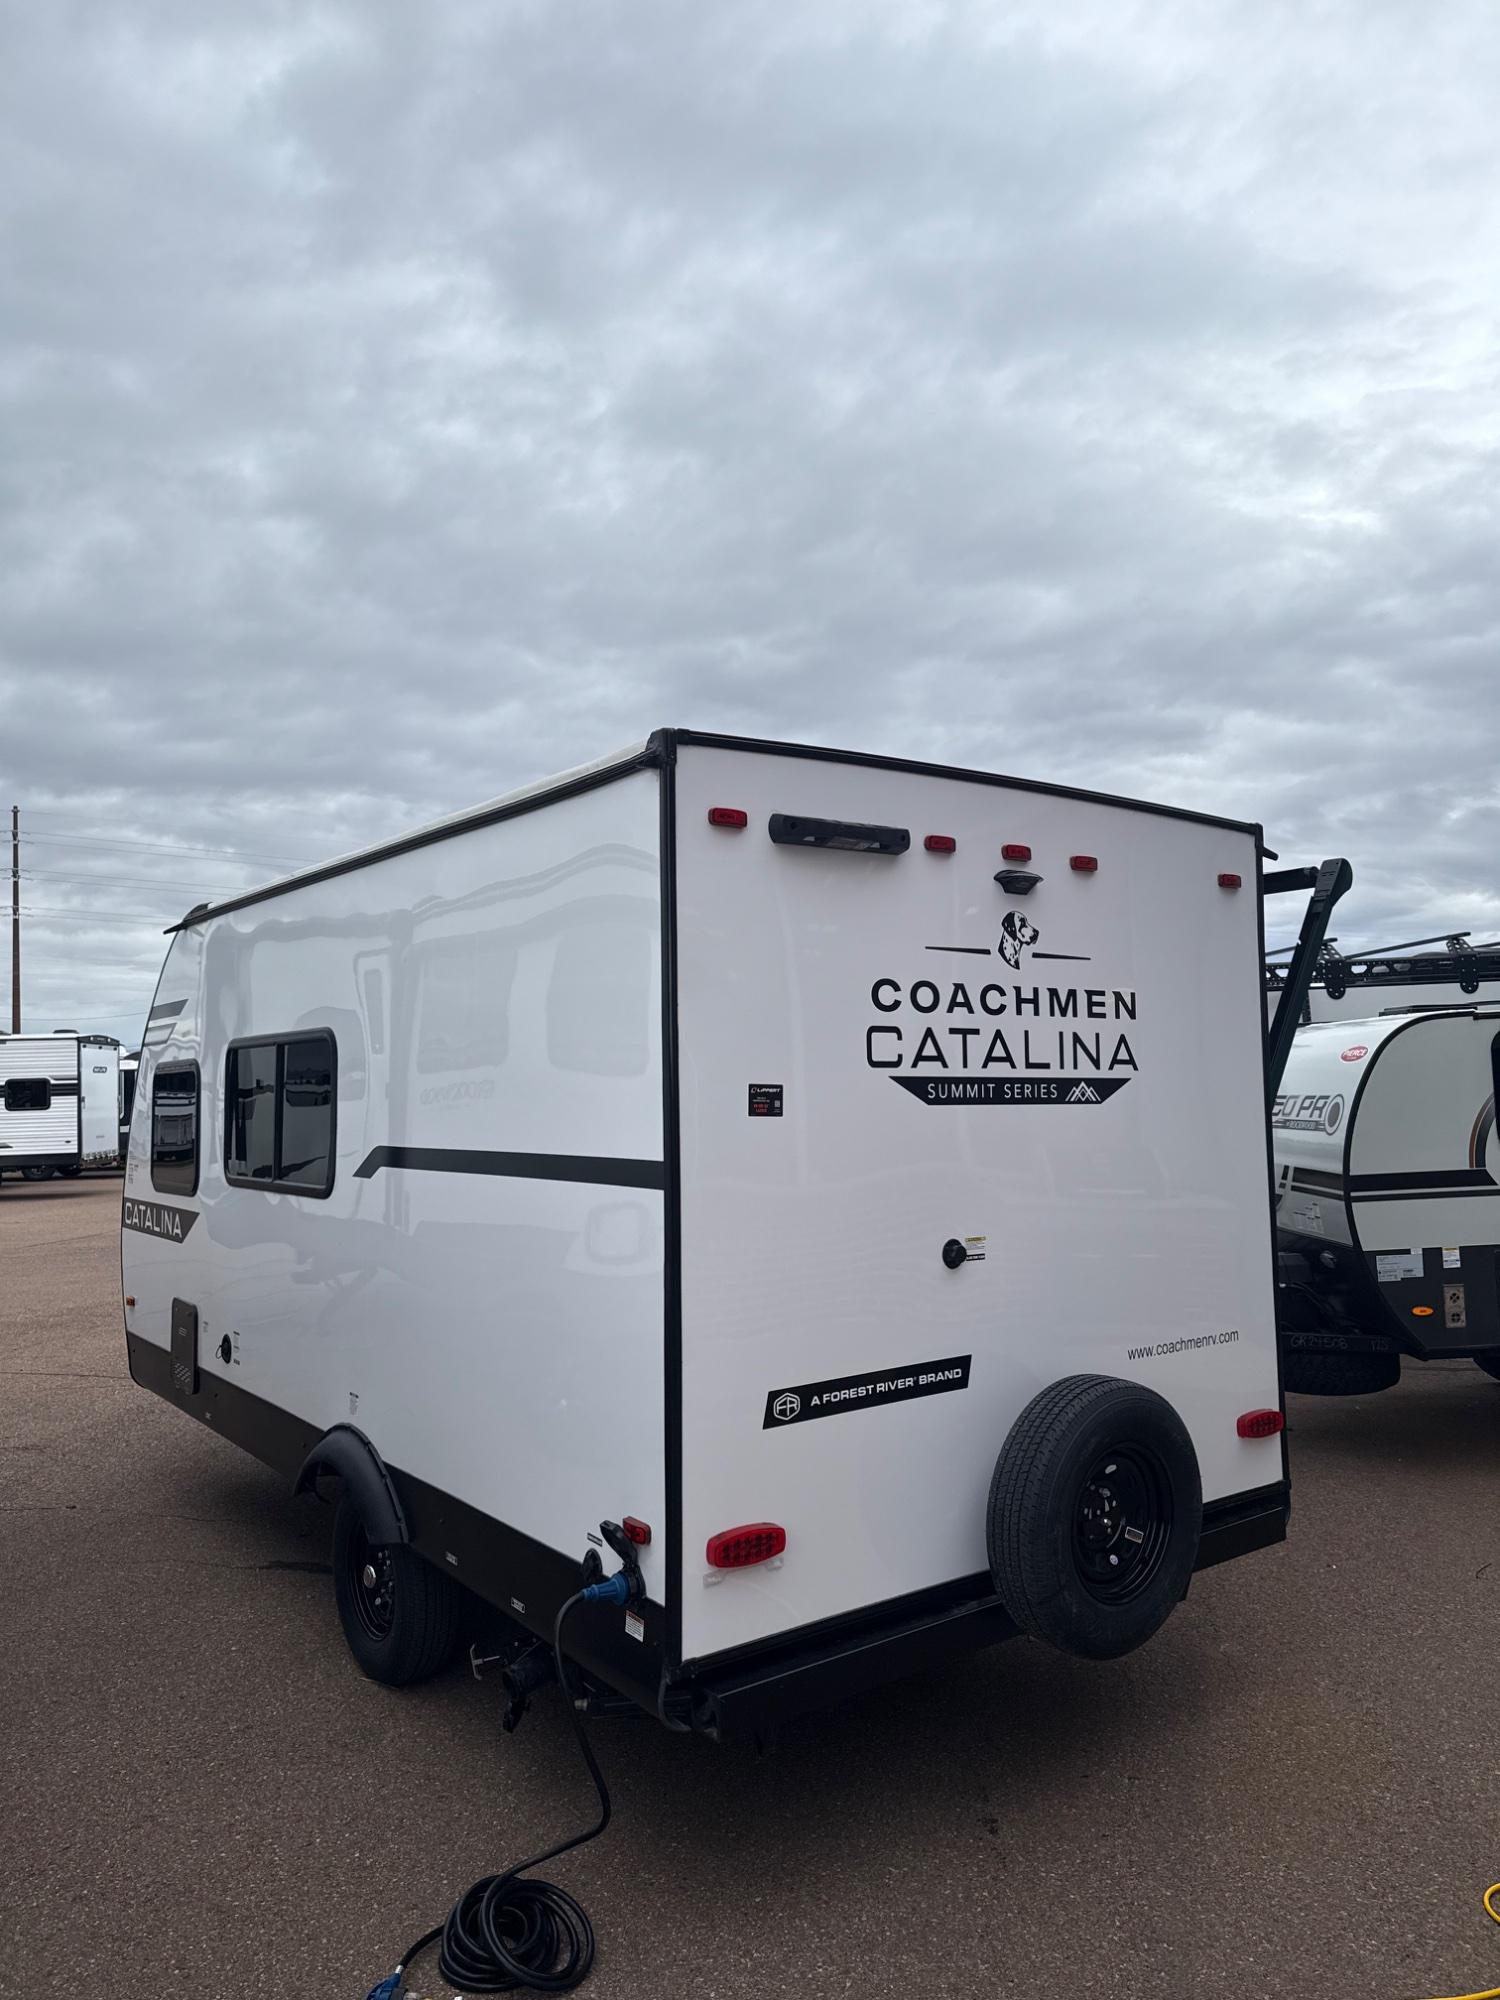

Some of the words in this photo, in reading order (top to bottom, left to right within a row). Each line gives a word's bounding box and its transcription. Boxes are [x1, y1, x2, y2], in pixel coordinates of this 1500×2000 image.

[871, 978, 1137, 1020] COACHMEN
[866, 1025, 1139, 1071] CATALINA
[927, 1083, 996, 1099] SUMMIT
[1003, 1083, 1058, 1099] SERIES
[124, 1202, 183, 1239] CATALINA
[1127, 1330, 1239, 1360] www.coachmenrv.com
[810, 1395, 821, 1407] A
[822, 1385, 875, 1404] FOREST
[918, 1368, 962, 1385] BRAND
